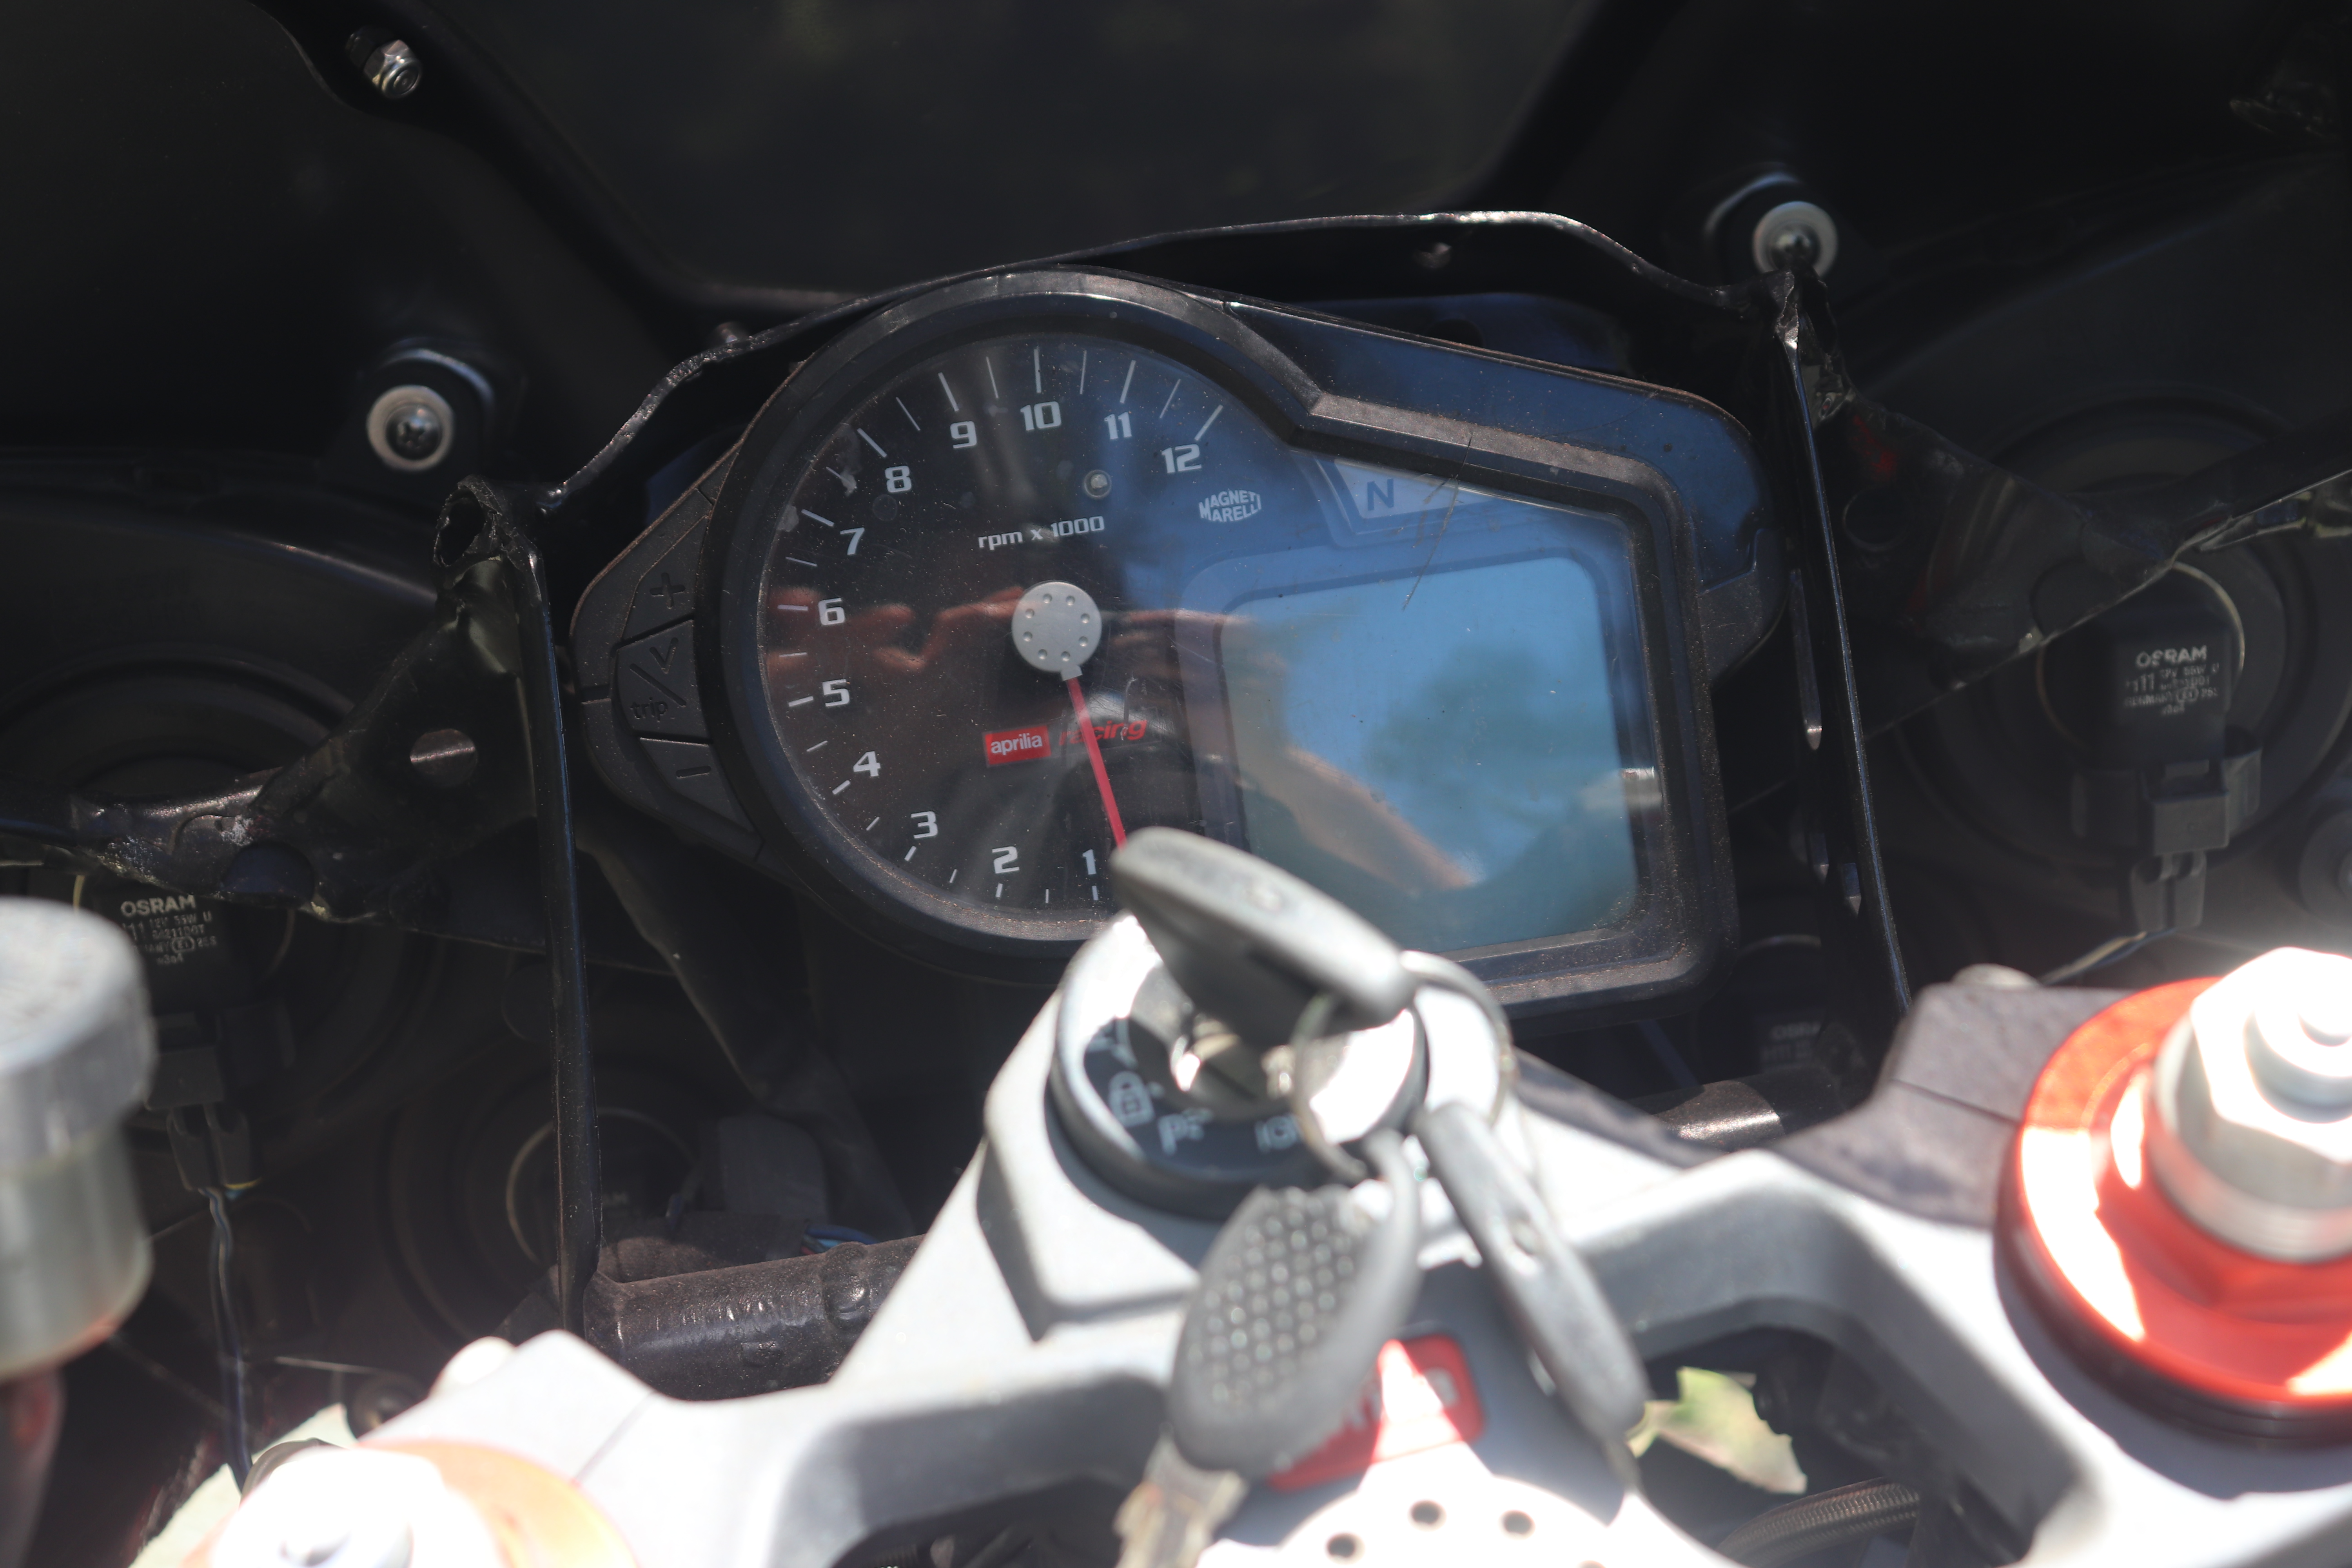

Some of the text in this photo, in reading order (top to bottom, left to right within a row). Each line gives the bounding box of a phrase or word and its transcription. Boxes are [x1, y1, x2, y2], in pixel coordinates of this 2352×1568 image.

[1020, 401, 1062, 431] 10
[1104, 412, 1132, 440] 11
[949, 421, 977, 449] 9
[1161, 443, 1202, 474] 12
[884, 465, 912, 493] 8
[1367, 478, 1394, 511] N
[840, 527, 865, 555] 7
[978, 516, 1105, 550] rpm x 1000
[817, 597, 845, 626] 6
[2136, 644, 2207, 667] OSRAM
[822, 679, 850, 707] 5
[630, 697, 668, 722] trip
[991, 732, 1043, 755] aprilia
[853, 751, 881, 777] 4
[911, 810, 938, 839] 3
[991, 846, 1020, 874] 2
[1082, 849, 1097, 875] 1
[120, 894, 196, 917] OSRAM
[122, 920, 144, 940] 11
[202, 910, 212, 923] U
